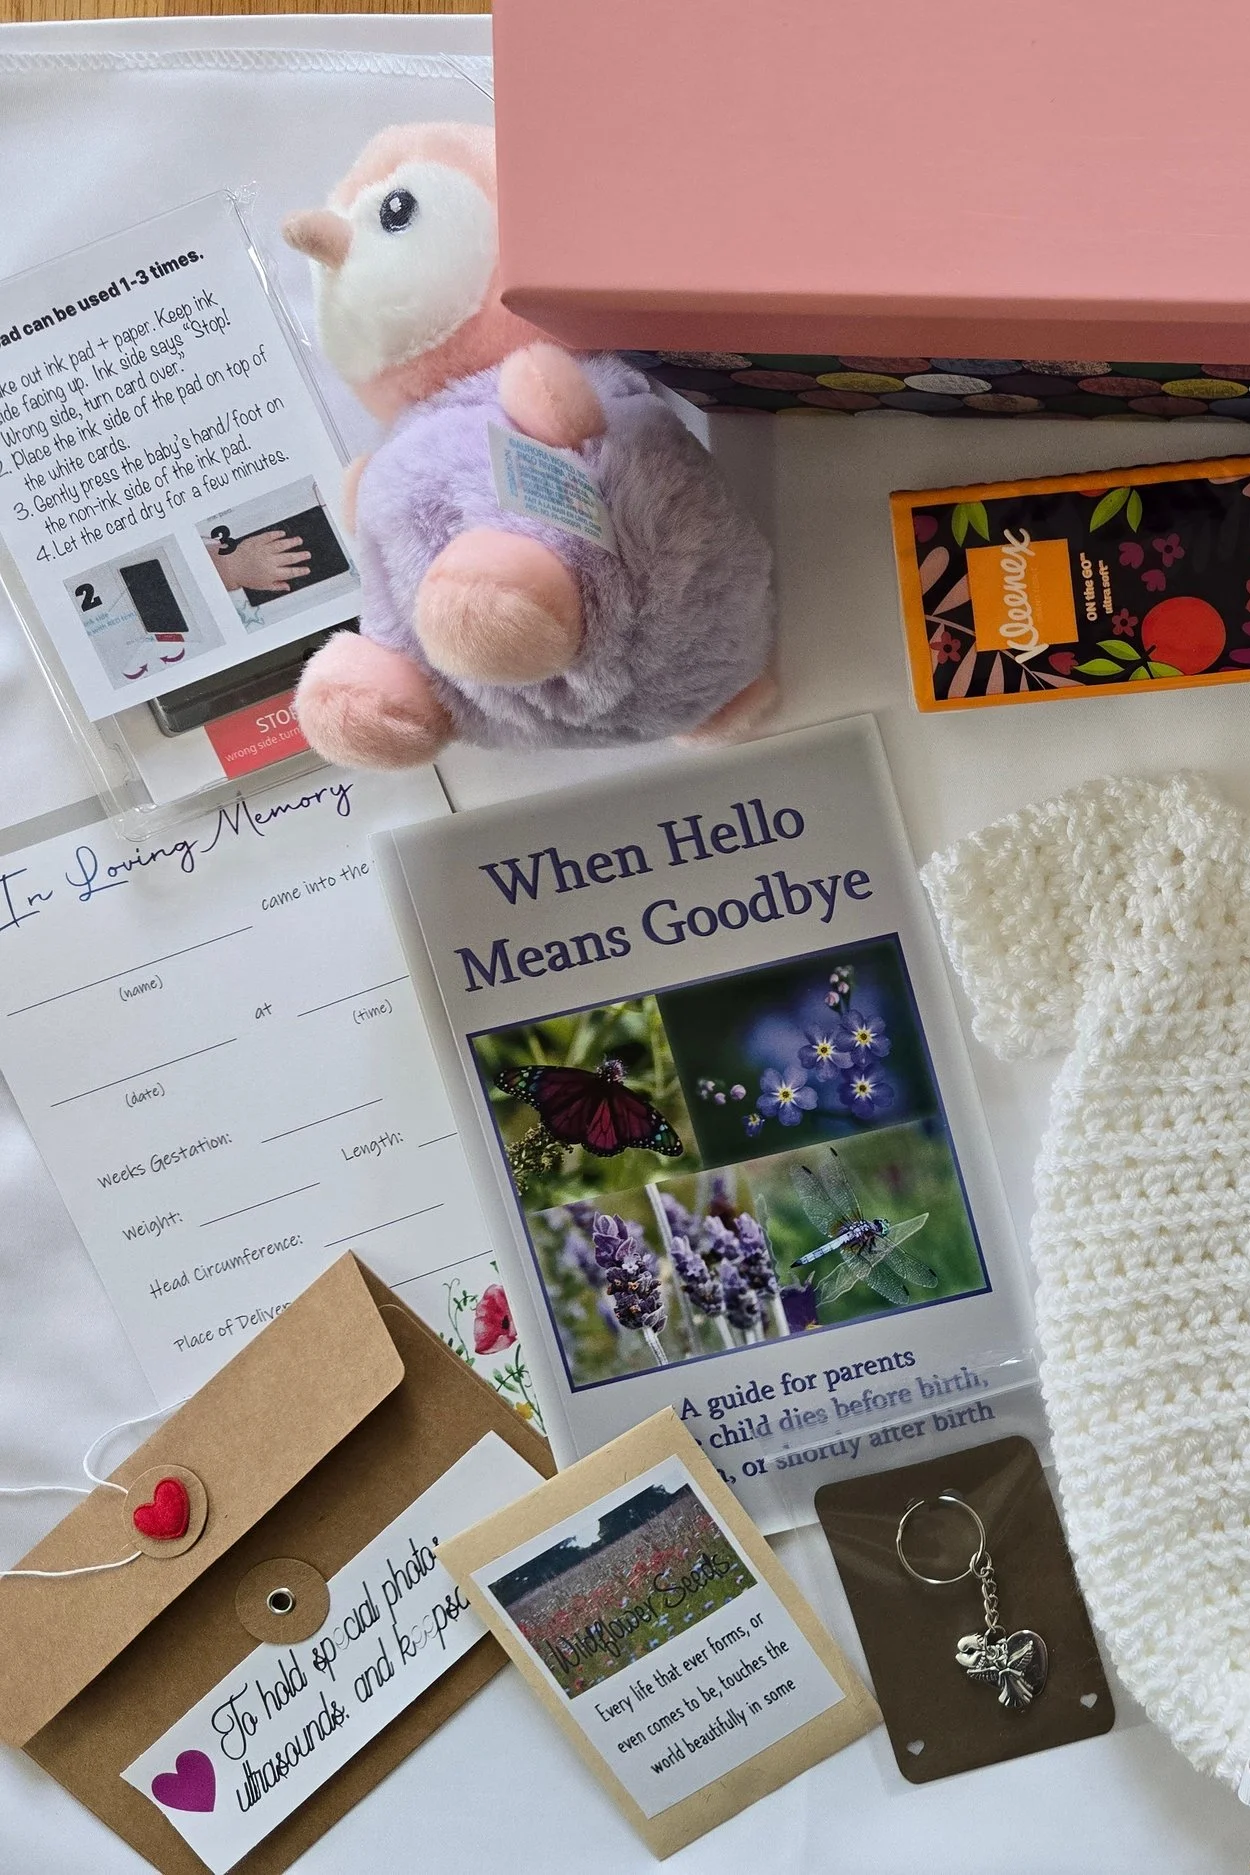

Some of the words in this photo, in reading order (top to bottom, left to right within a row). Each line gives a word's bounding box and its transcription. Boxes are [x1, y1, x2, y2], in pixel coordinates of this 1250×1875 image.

[0, 325, 22, 348] ad
[23, 315, 55, 335] can
[52, 305, 76, 322] be
[77, 281, 121, 311] used
[119, 270, 149, 291] 1-3
[149, 251, 203, 278] times.
[21, 366, 42, 387] out
[43, 355, 68, 376] ink
[68, 340, 95, 371] pad
[97, 337, 108, 349] +
[112, 321, 155, 352] paper.
[154, 304, 192, 328] Keep
[193, 289, 218, 311] ink
[13, 503, 33, 521] 3.
[33, 483, 80, 512] Gently
[79, 468, 119, 499] press
[121, 456, 144, 475] the
[143, 434, 191, 465] baby's
[189, 404, 262, 444] hand/foot
[267, 398, 284, 413] on
[80, 527, 103, 545] the
[106, 507, 137, 534] card
[140, 502, 165, 520] dry
[166, 490, 185, 508] for
[192, 486, 202, 497] a
[203, 473, 229, 492] few
[231, 451, 289, 480] minutes.
[210, 525, 237, 555] 3
[75, 583, 102, 612] 2
[999, 527, 1050, 663] Kleenex
[1084, 580, 1094, 600] the
[1086, 602, 1096, 620] ON
[1103, 588, 1112, 613] ultra
[225, 744, 257, 762] wrong
[0, 868, 53, 930] In
[65, 845, 200, 902] Loving
[200, 781, 354, 853] Memory
[478, 845, 653, 904] When
[657, 798, 804, 866] Hello
[262, 888, 300, 910] came
[303, 877, 336, 894] into
[340, 863, 369, 880] the
[454, 926, 630, 992] Means
[642, 870, 873, 945] Goodbye
[119, 975, 163, 1001] (name)
[255, 1002, 273, 1020] at
[352, 999, 393, 1025] (time)
[125, 1082, 165, 1107] (date)
[97, 1164, 145, 1188] Weeks
[150, 1134, 232, 1172] Gestation:
[341, 1132, 403, 1160] Length:
[122, 1212, 182, 1240] Weight:
[150, 1271, 189, 1299] Head
[194, 1235, 302, 1280] Circumference:
[173, 1330, 213, 1351] Place
[218, 1319, 232, 1336] of
[236, 1301, 291, 1333] Deliver
[680, 1398, 701, 1420] A
[707, 1381, 775, 1420] guide
[780, 1372, 816, 1395] for
[823, 1351, 915, 1392] parents
[710, 1413, 772, 1449] child
[779, 1406, 829, 1434] dies
[833, 1386, 913, 1420] before
[917, 1366, 990, 1400] birth,
[741, 1454, 768, 1480] or
[933, 1401, 996, 1433] birth
[354, 1637, 394, 1702] and
[392, 1587, 470, 1665] keepsa
[545, 1604, 657, 1674] Wildflower
[652, 1554, 730, 1609] Seeds
[594, 1696, 633, 1722] Every
[629, 1680, 655, 1701] life
[653, 1663, 682, 1687] that
[683, 1649, 708, 1671] ever
[706, 1626, 750, 1654] forms,
[750, 1613, 763, 1628] or
[618, 1732, 646, 1753] even
[647, 1708, 684, 1735] comes
[682, 1698, 699, 1711] to
[696, 1686, 722, 1702] be,
[717, 1656, 767, 1689] touches
[765, 1641, 789, 1659] the
[211, 1683, 271, 1760] To
[255, 1649, 307, 1719] hold
[650, 1742, 685, 1773] world
[681, 1708, 747, 1753] beautifully
[746, 1701, 762, 1714] in
[764, 1680, 795, 1704] some
